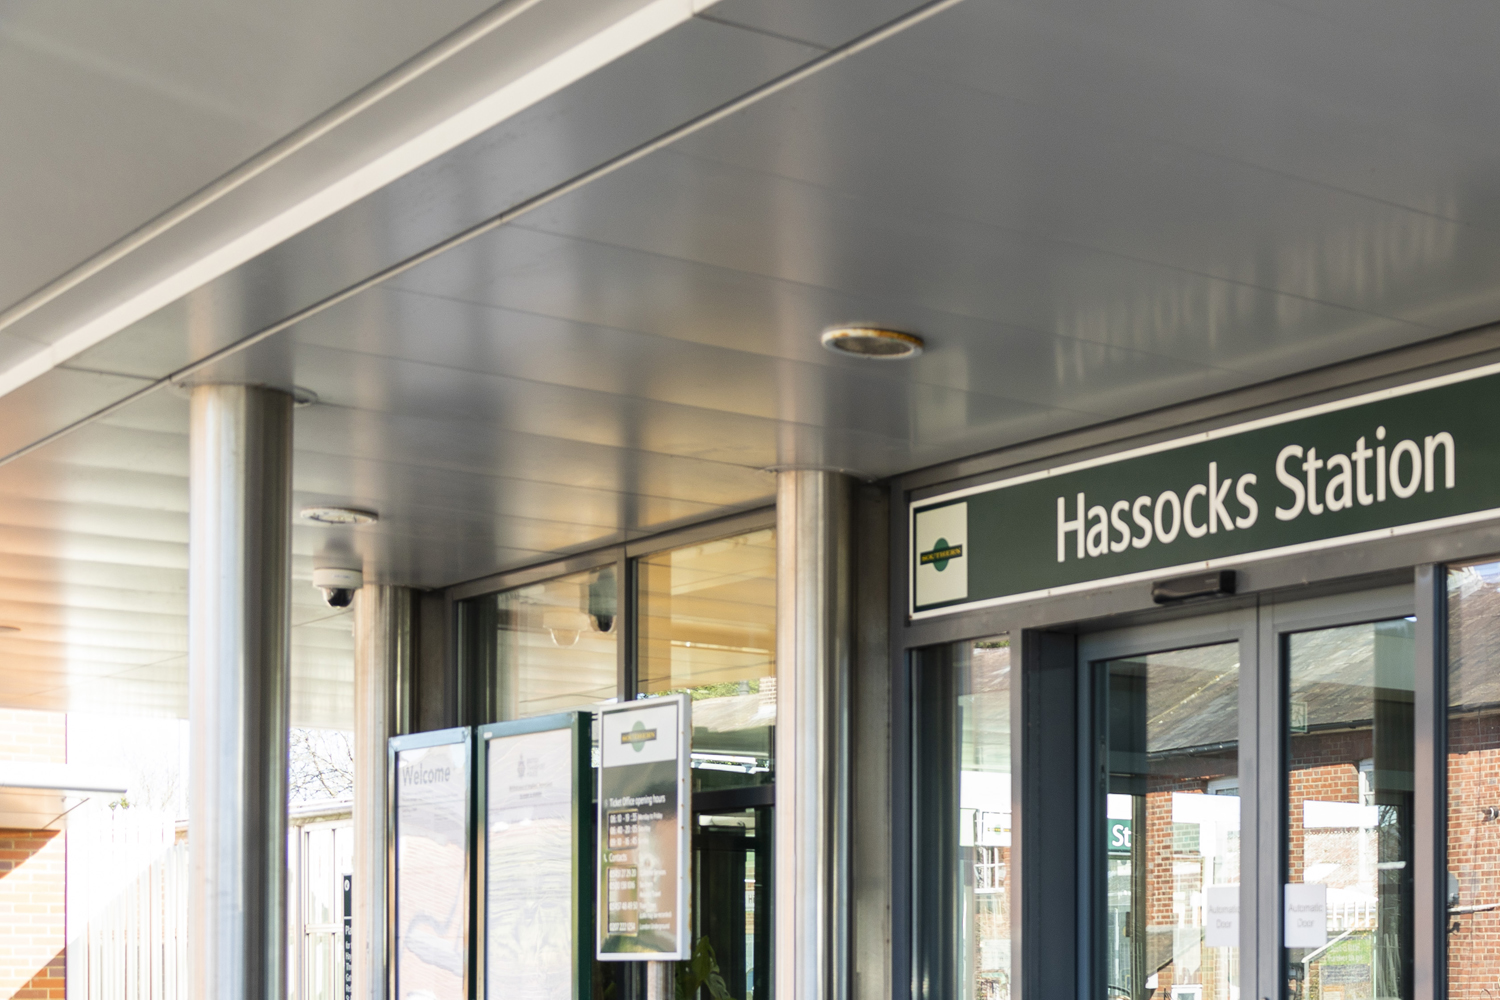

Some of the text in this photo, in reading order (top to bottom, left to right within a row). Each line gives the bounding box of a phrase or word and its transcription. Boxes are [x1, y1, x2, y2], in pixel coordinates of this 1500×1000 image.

[1055, 425, 1456, 563] Hassocks Station
[921, 547, 962, 562] SOUTHERN
[402, 762, 451, 787] Welcome
[1288, 903, 1324, 913] Automatic
[1297, 918, 1315, 928] Door
